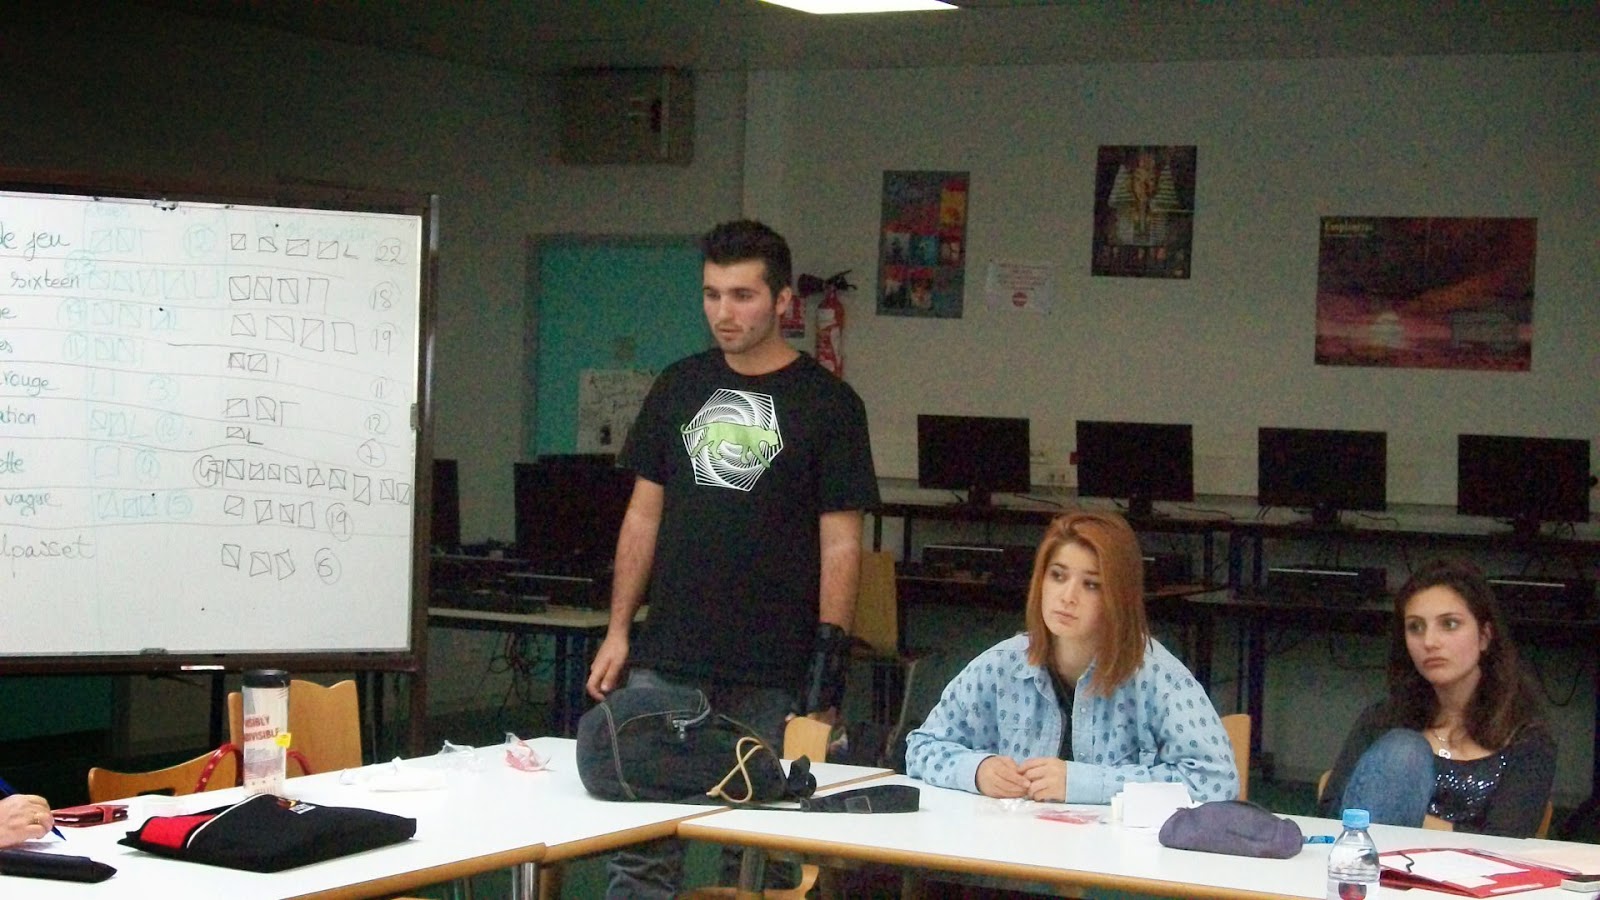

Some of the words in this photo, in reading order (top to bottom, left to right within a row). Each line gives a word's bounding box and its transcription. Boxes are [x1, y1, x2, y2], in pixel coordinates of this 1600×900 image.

[24, 231, 70, 261] jeu
[375, 245, 406, 264] 22
[11, 269, 80, 290] sixteen
[372, 289, 392, 310] 18
[375, 328, 392, 356] 19
[3, 370, 59, 396] rouge
[4, 491, 61, 516] vague
[331, 510, 347, 534] 19
